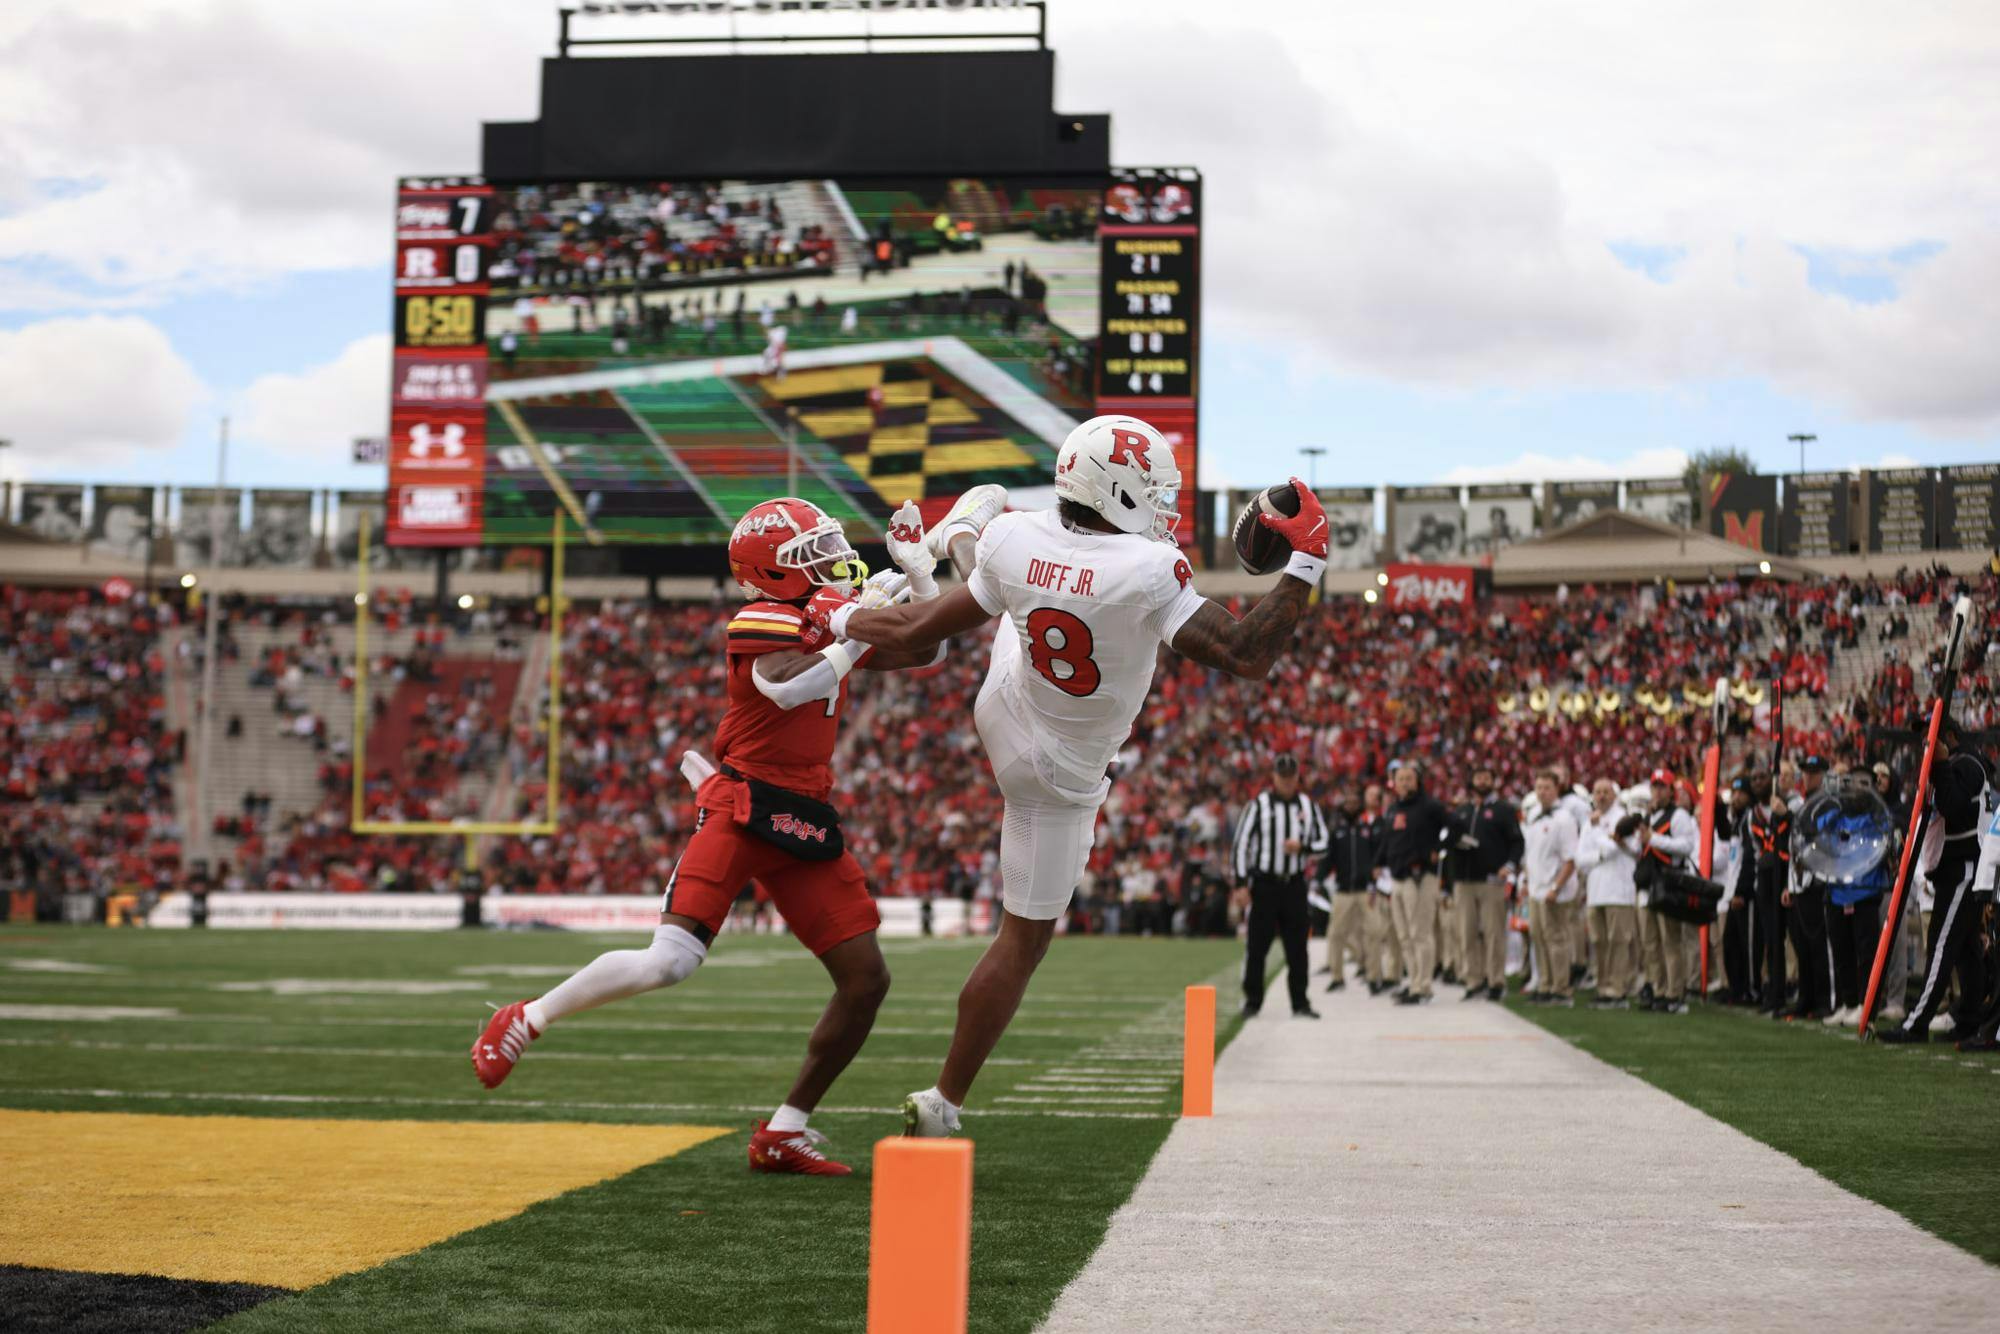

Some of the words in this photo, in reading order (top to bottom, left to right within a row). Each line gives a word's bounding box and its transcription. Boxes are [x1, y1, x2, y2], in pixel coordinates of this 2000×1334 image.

[457, 197, 481, 234] 7
[404, 247, 437, 278] R
[1108, 428, 1151, 472] R
[1722, 510, 1763, 553] M
[1026, 558, 1072, 592] DUFF
[1070, 568, 1094, 597] JR.
[1026, 607, 1101, 697] 8
[770, 814, 827, 843] Terps
